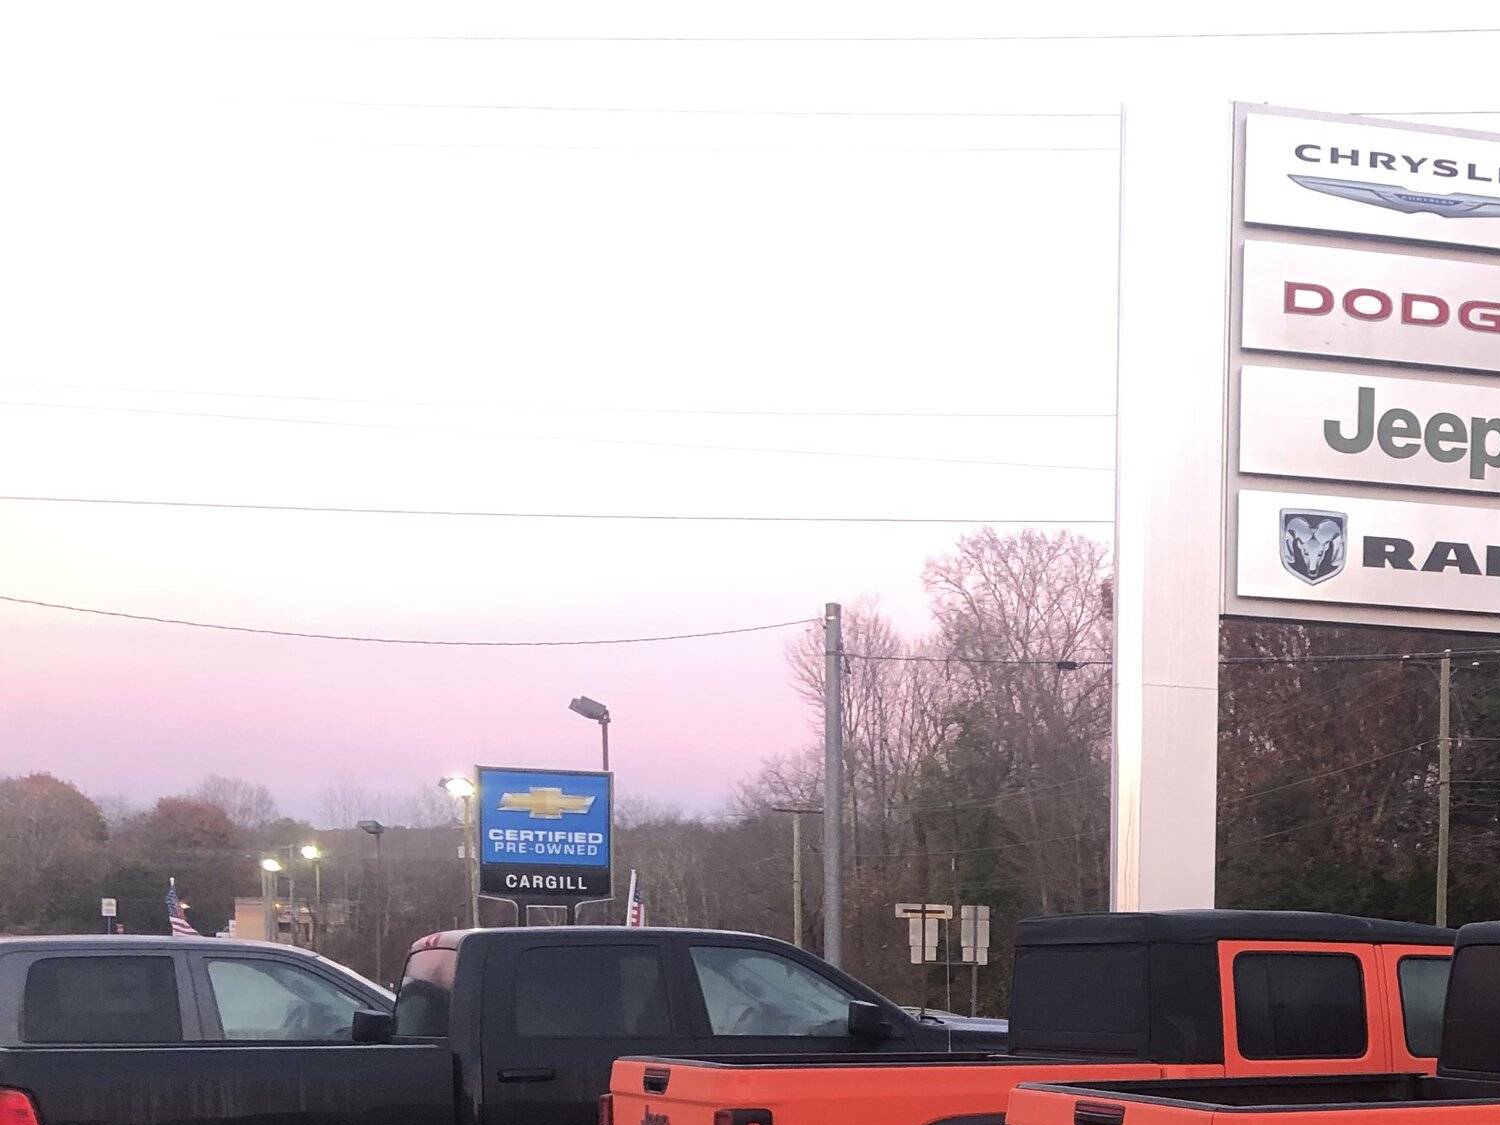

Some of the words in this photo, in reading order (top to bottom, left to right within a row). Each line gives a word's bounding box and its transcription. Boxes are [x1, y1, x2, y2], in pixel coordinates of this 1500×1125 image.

[488, 828, 603, 844] CERTIFIED
[494, 842, 598, 856] PRE-OWNED
[505, 874, 588, 890] CARGILL
